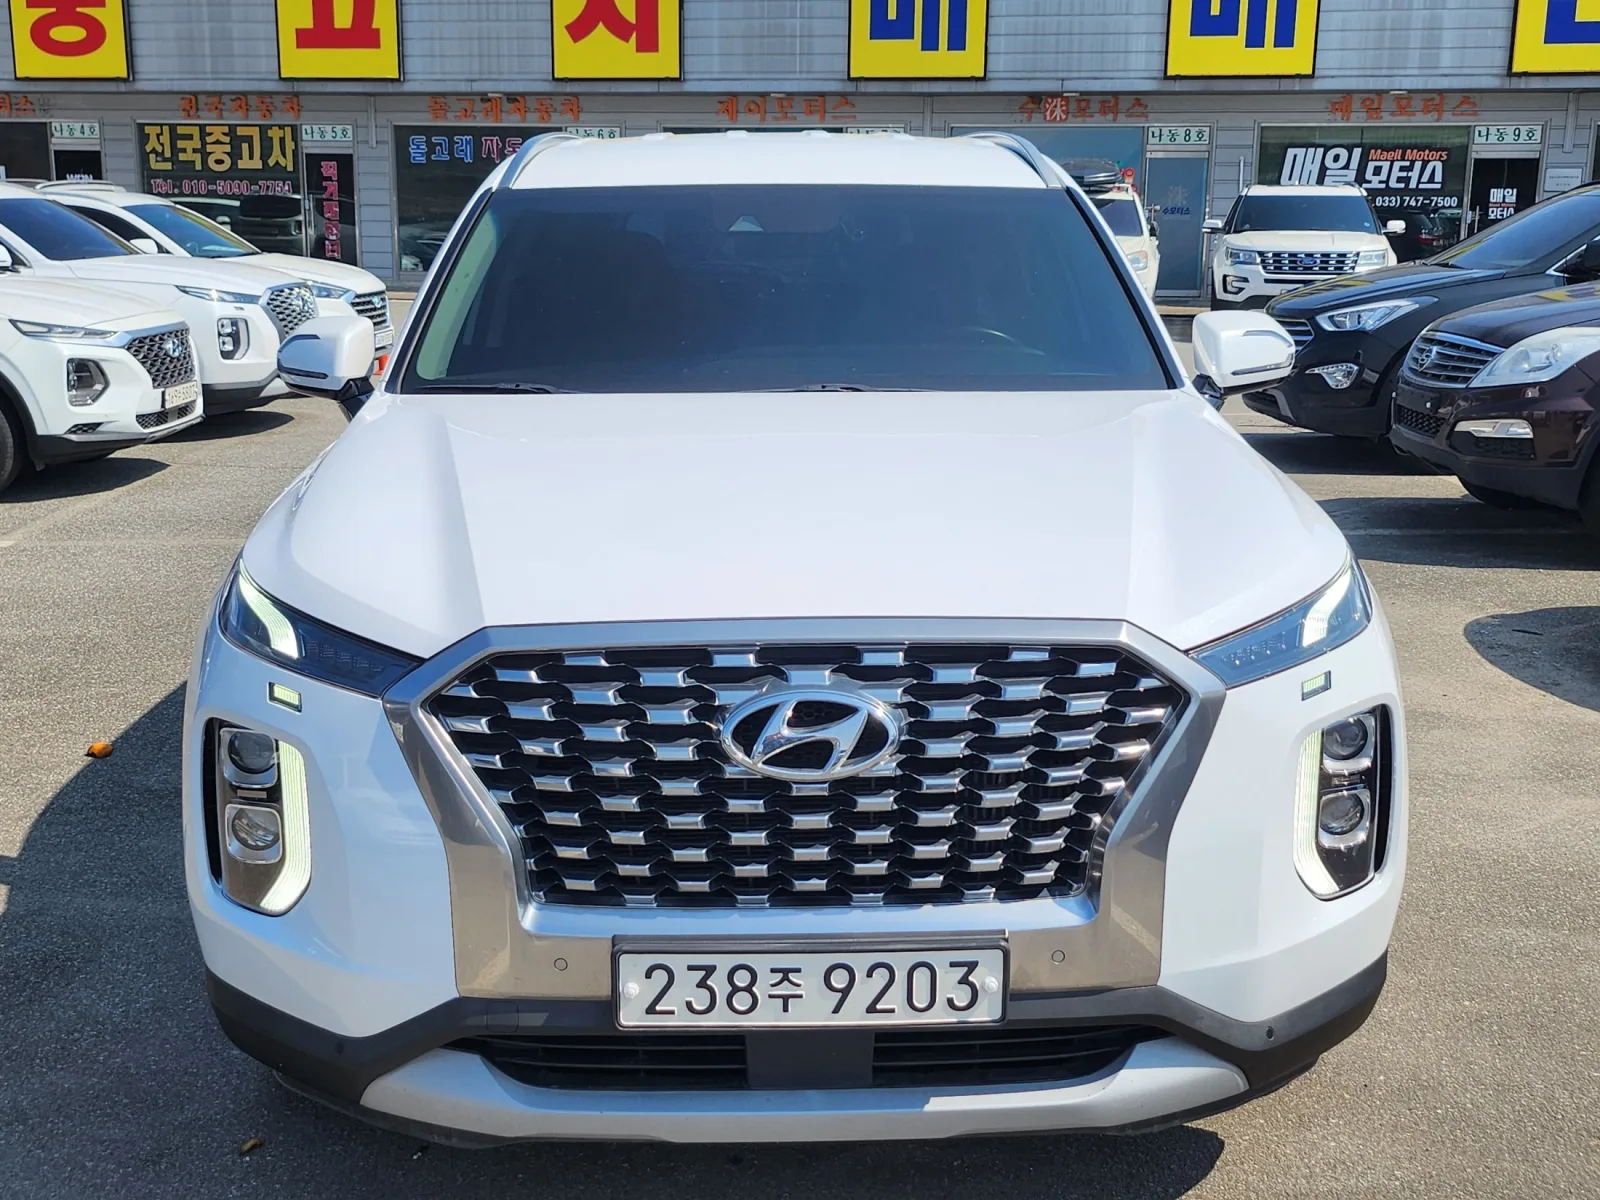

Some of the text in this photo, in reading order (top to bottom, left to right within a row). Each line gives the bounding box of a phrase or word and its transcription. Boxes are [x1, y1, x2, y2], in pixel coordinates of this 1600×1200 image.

[179, 93, 303, 120] 전국자동차
[427, 95, 583, 122] 돌고래자동차
[716, 94, 857, 124] 제이모터스
[1330, 92, 1478, 121] 매일모터스
[144, 125, 295, 172] 전국중고차
[409, 135, 474, 164] 돌고래
[1369, 148, 1448, 161] Maeil Motors
[1280, 146, 1362, 186] 매일
[1362, 160, 1443, 190] 모터스
[182, 179, 292, 195] 010-5090-7754
[1403, 196, 1457, 207] 747-7500
[1490, 188, 1517, 203] 매일
[644, 960, 980, 1016] 238주 9203
